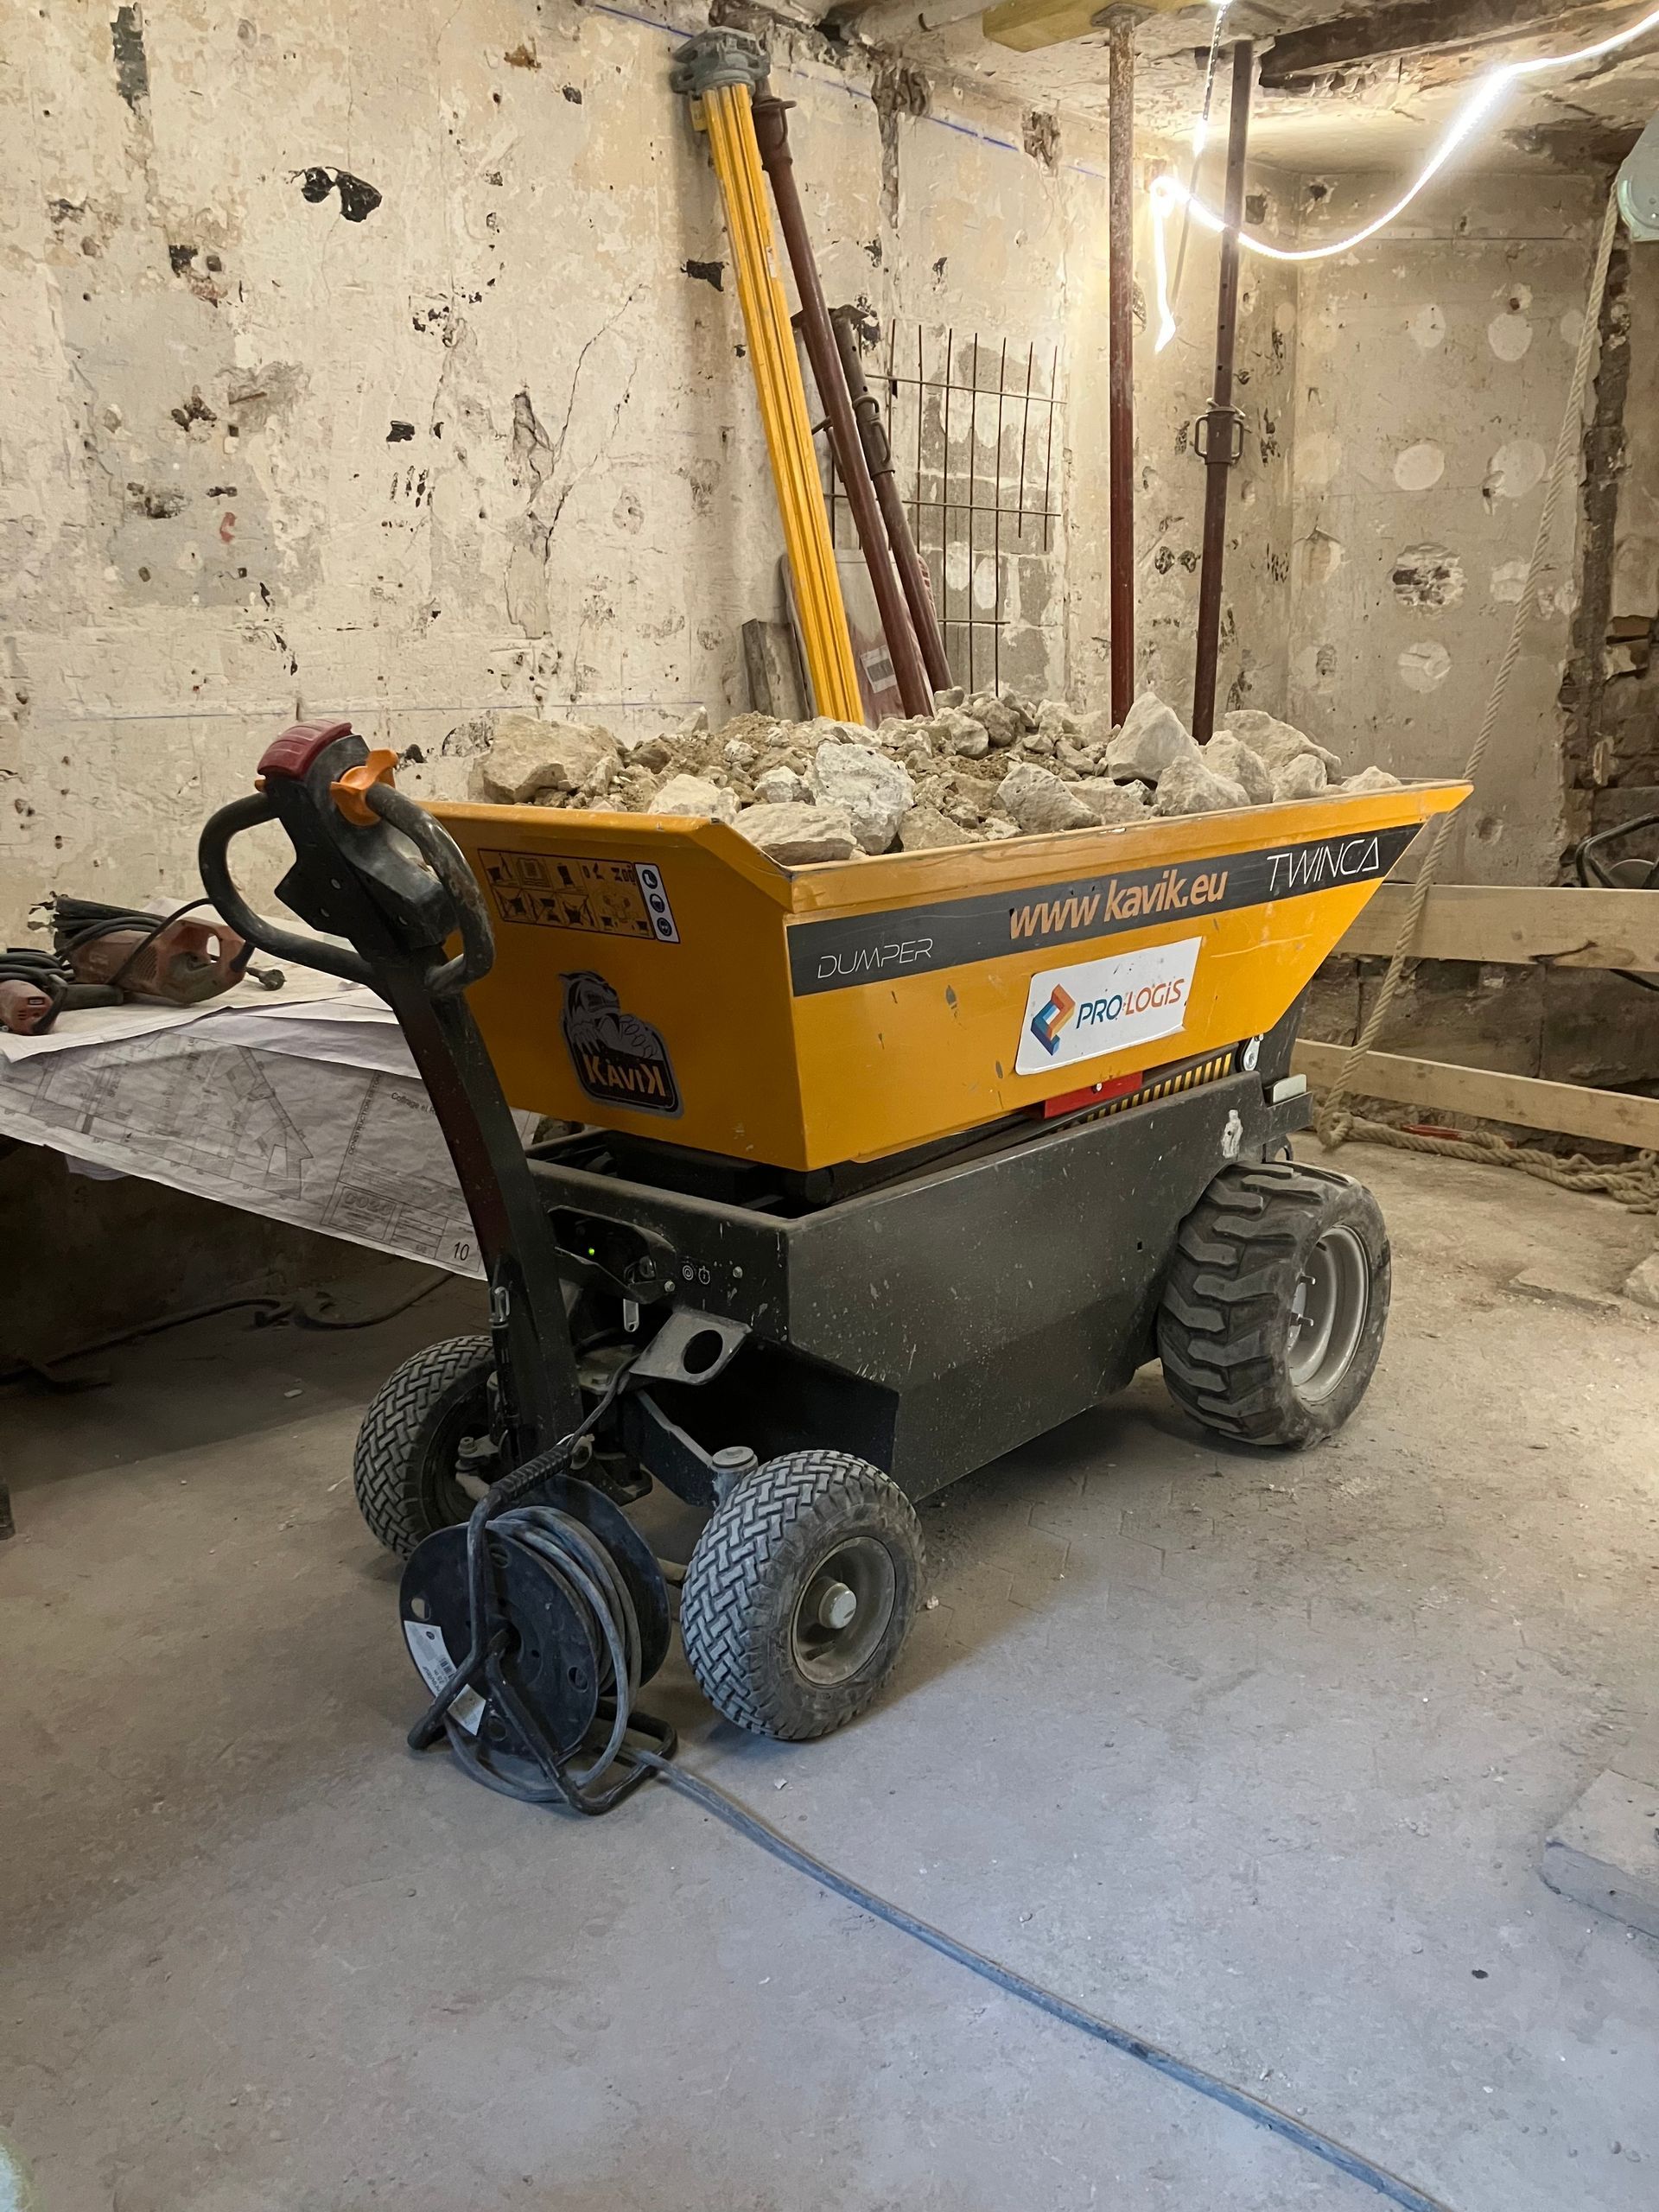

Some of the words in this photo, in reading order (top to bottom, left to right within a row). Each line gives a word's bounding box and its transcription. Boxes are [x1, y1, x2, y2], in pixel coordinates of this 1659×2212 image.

[1267, 836, 1380, 892] TWINCA
[1103, 868, 1229, 923] kavik.eu
[817, 938, 933, 979] DUMPER
[454, 1241, 470, 1262] 10
